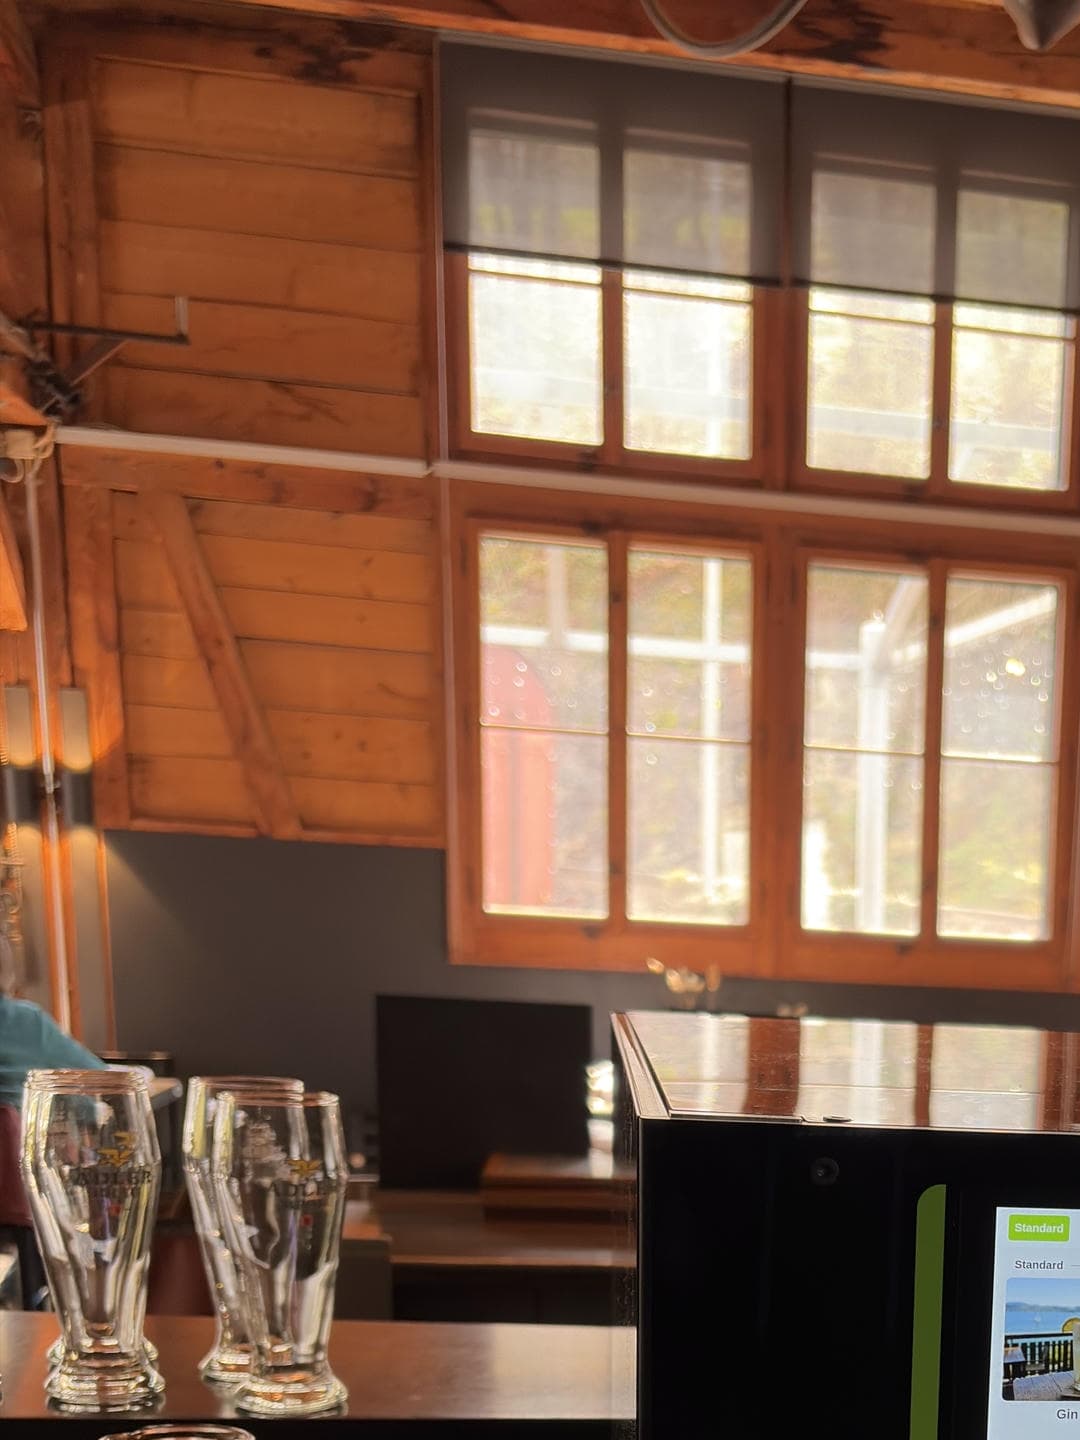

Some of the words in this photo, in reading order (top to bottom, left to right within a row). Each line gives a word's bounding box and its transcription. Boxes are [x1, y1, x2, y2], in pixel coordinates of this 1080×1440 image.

[1014, 1222, 1064, 1234] Standard
[1014, 1260, 1064, 1270] Standard
[1056, 1409, 1078, 1421] Gin
